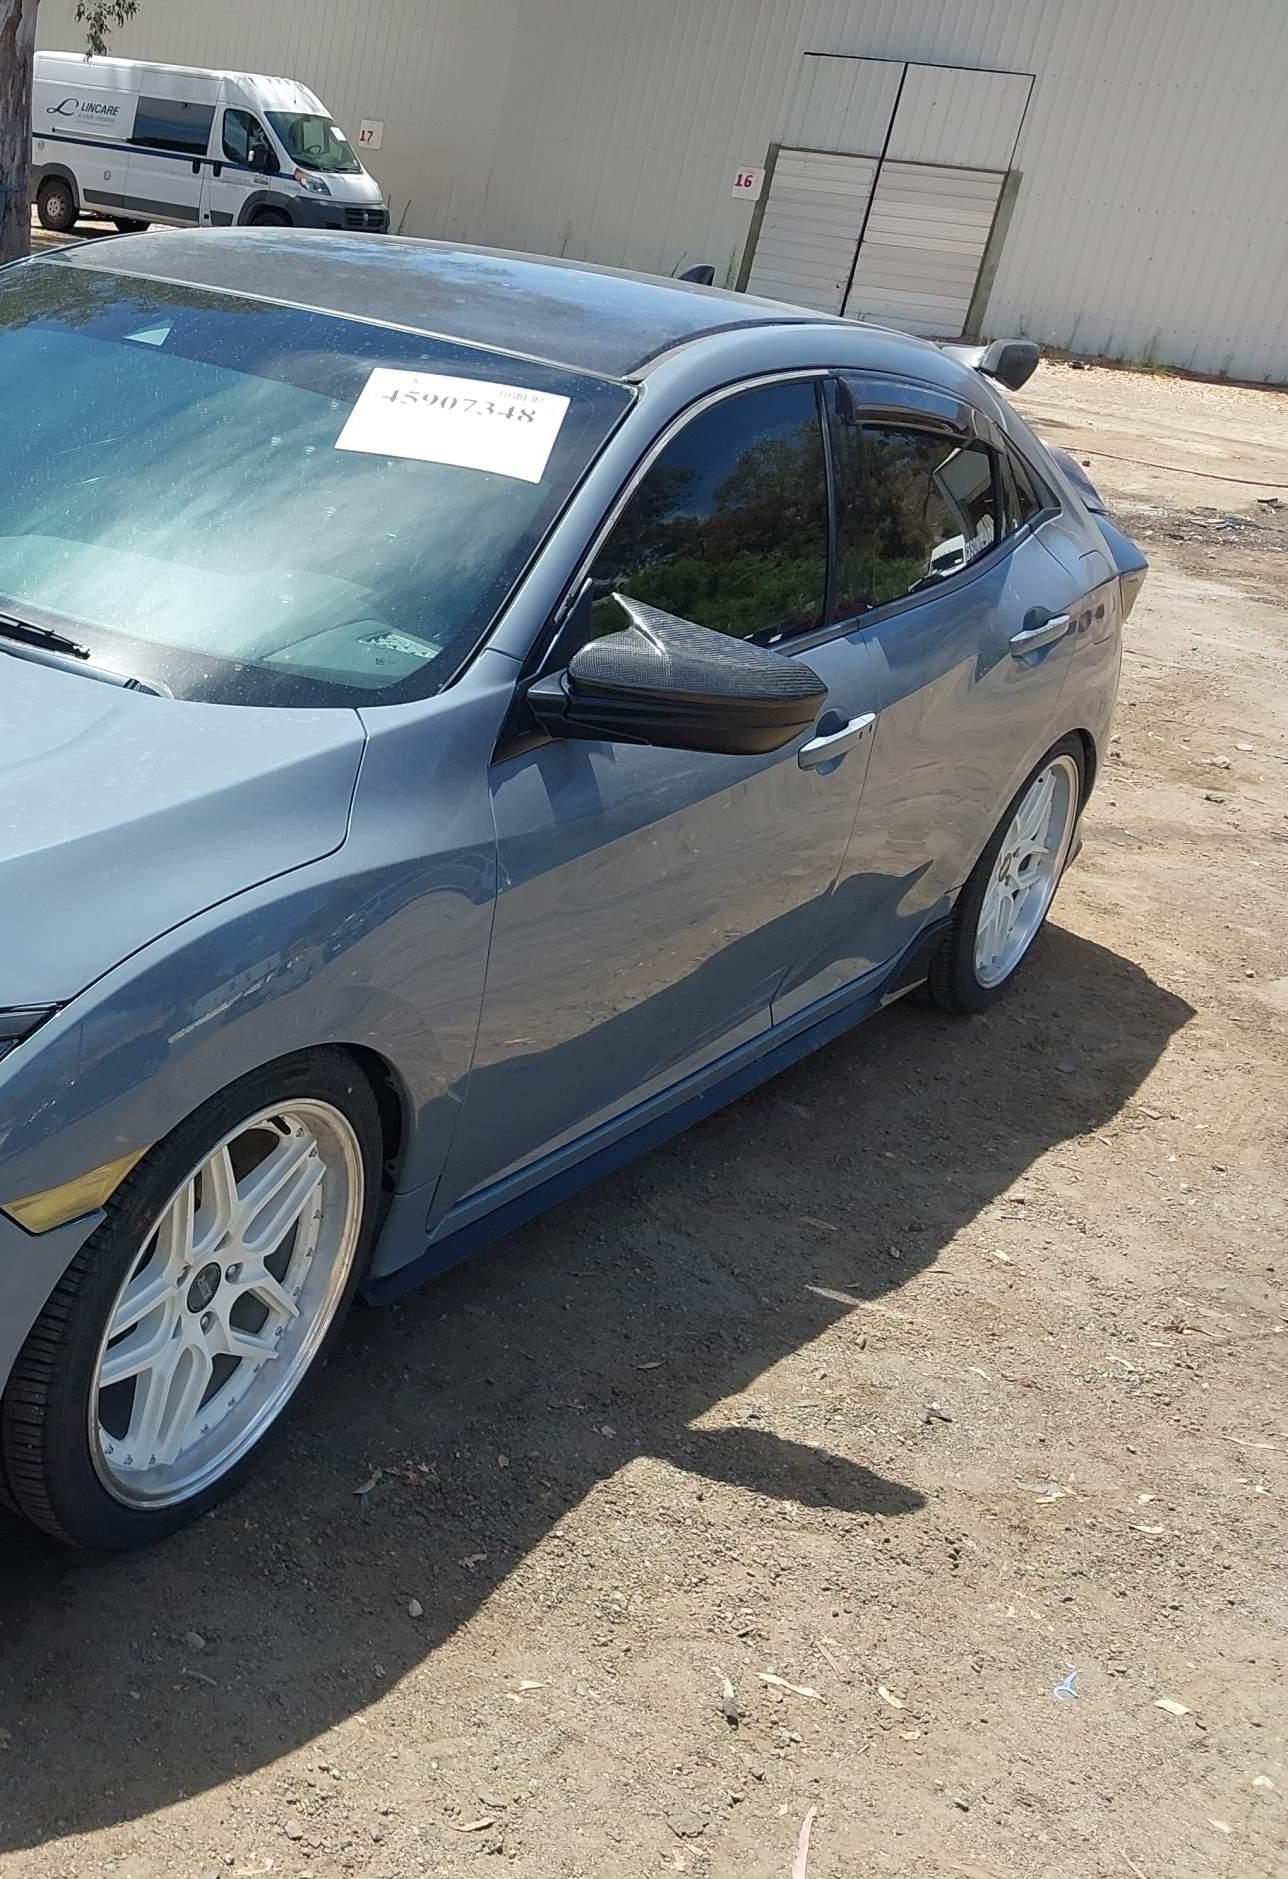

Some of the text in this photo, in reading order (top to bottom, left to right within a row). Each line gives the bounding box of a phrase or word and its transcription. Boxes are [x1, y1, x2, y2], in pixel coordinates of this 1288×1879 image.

[80, 101, 120, 117] LINCARE
[359, 129, 374, 143] 17
[734, 173, 754, 188] 16
[381, 388, 536, 424] 45907348
